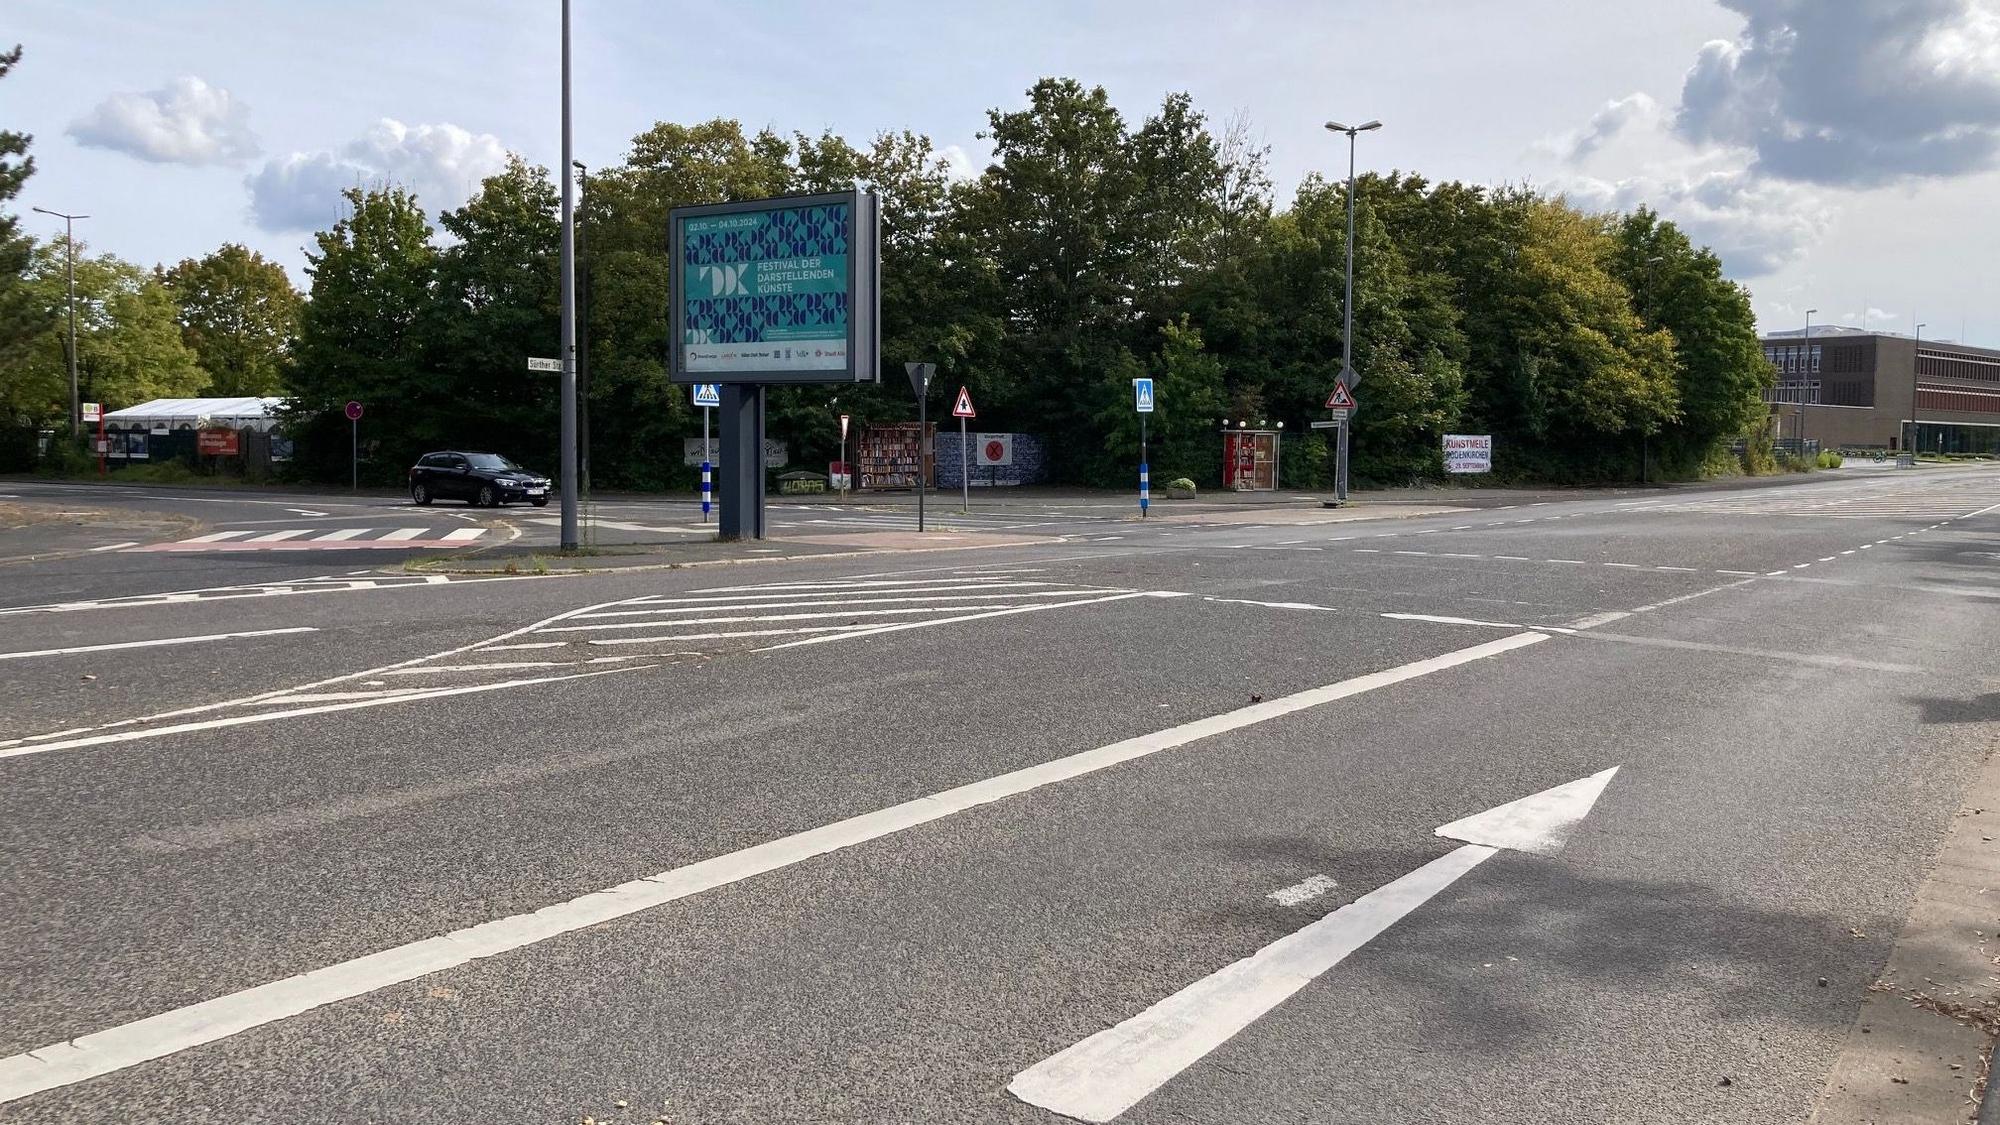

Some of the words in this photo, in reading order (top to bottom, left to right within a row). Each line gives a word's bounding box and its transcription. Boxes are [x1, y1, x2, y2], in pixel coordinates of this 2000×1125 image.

[718, 217, 758, 229] 04.10.2024
[757, 260, 799, 270] FESTIVAL
[801, 258, 821, 268] DER
[757, 269, 834, 282] DARSTELLENDEN
[757, 282, 793, 294] KÜNSTE
[529, 359, 551, 368] Sürther
[1446, 439, 1489, 449] KUNSTMEILE
